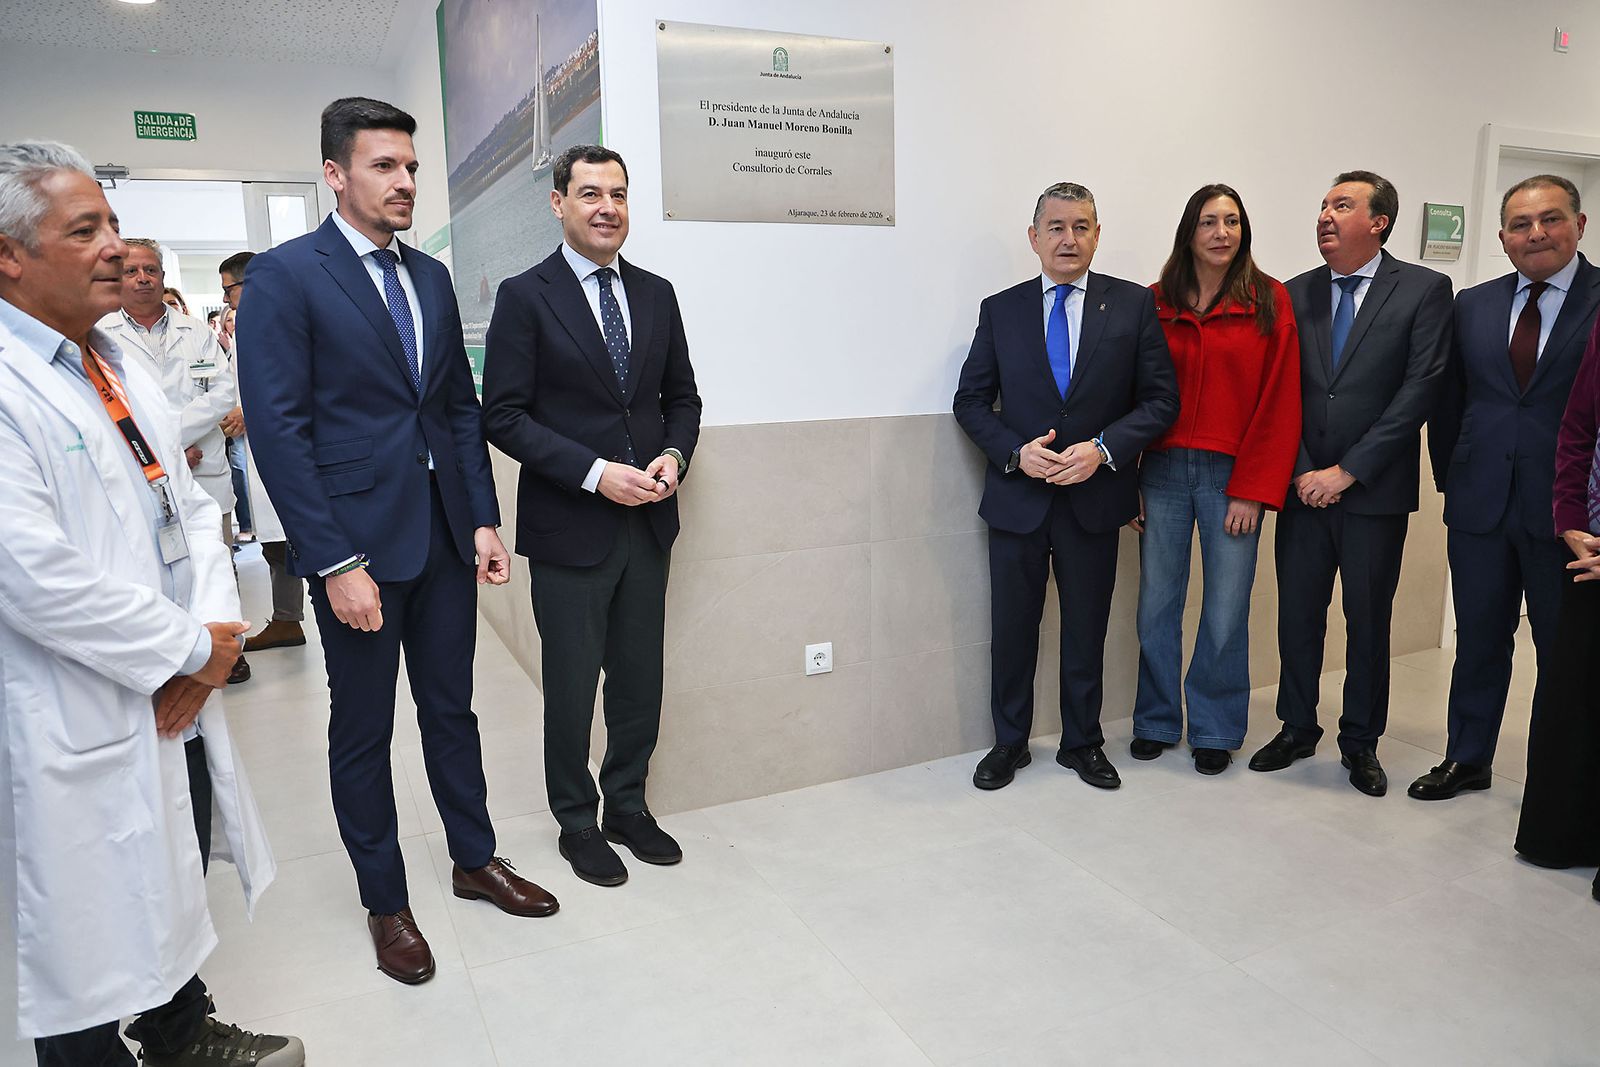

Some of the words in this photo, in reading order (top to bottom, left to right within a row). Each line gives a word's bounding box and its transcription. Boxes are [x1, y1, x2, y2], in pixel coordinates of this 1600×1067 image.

[700, 100, 709, 110] El
[712, 101, 757, 113] presidente
[760, 104, 770, 114] de
[772, 105, 780, 115] la
[782, 106, 804, 117] Junta
[807, 107, 817, 117] de
[819, 109, 860, 120] Andalucía
[137, 114, 173, 126] SALIDA
[179, 116, 192, 127] DE
[708, 116, 719, 127] D.
[721, 118, 745, 128] Juan
[748, 119, 782, 130] Manuel
[785, 121, 820, 133] Moreno
[822, 124, 853, 135] Bonilla
[138, 126, 195, 138] EMERGENCIA
[755, 147, 793, 160] inauguró
[794, 151, 811, 160] este
[732, 162, 783, 174] Consultorio
[785, 165, 796, 174] de
[797, 165, 833, 176] Corrales
[787, 209, 819, 218] Aljaraque,
[820, 209, 828, 217] 23
[838, 210, 859, 218] febrero
[1430, 208, 1452, 217] Consulta
[1451, 215, 1461, 239] 2
